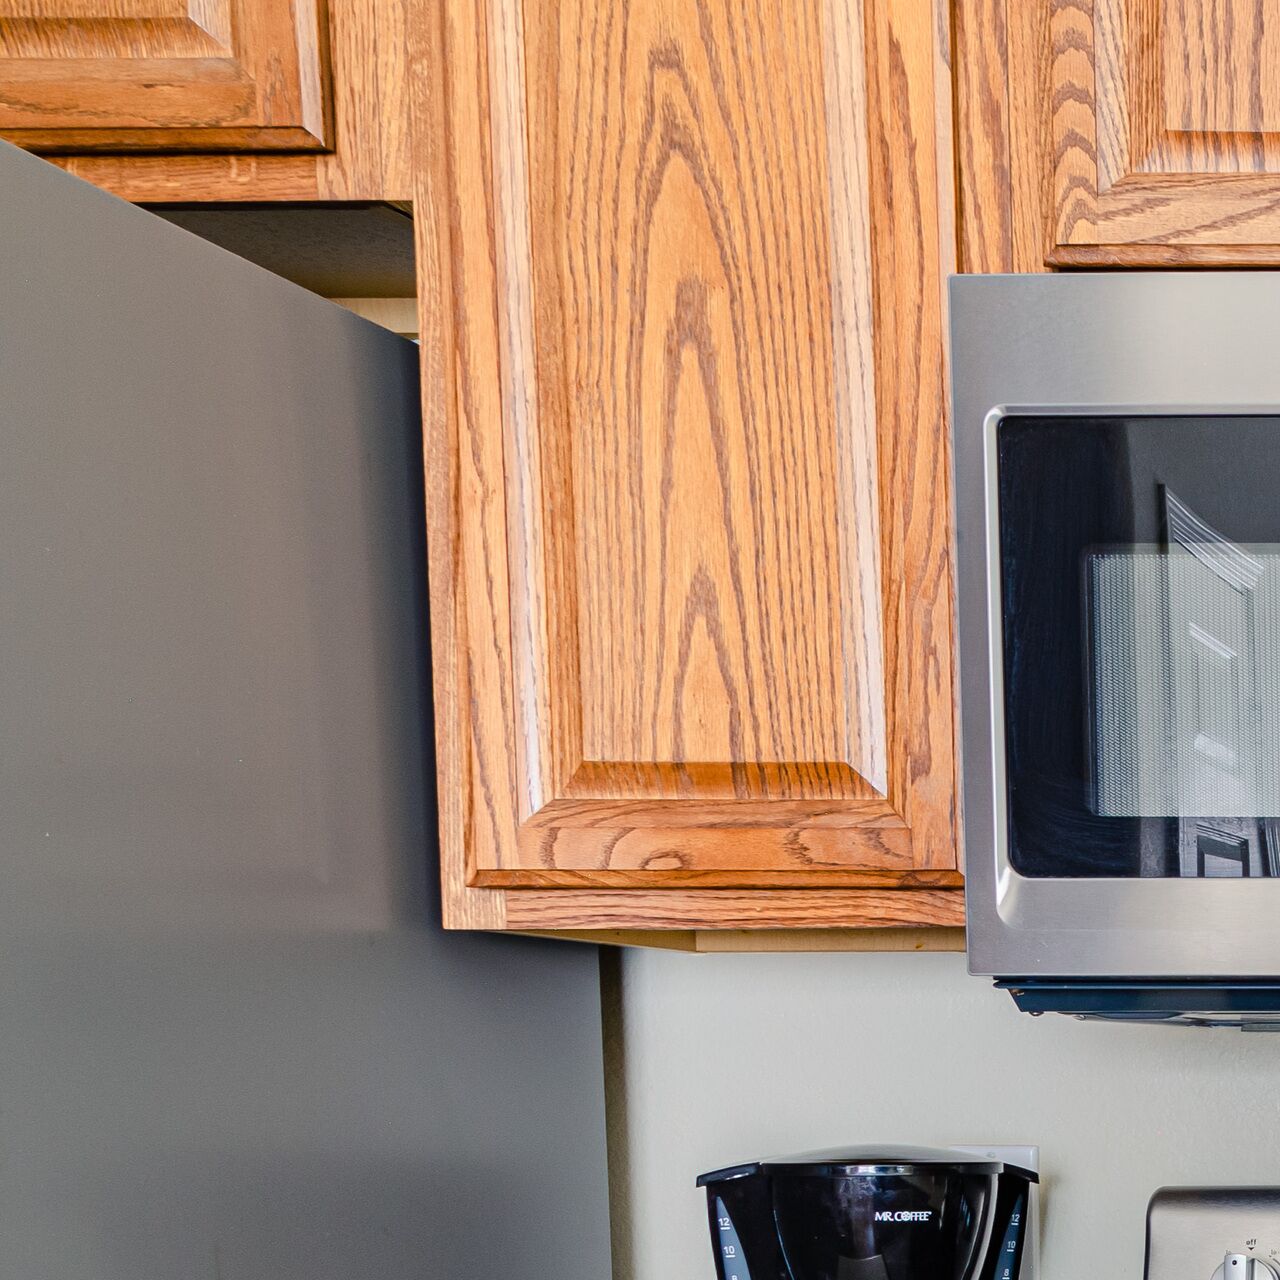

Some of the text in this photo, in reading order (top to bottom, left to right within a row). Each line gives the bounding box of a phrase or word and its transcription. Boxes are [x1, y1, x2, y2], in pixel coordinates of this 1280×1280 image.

[894, 1211, 929, 1221] COFFEE
[1011, 1214, 1020, 1222] 12
[718, 1217, 730, 1226] 12
[1007, 1241, 1016, 1249] 10
[724, 1246, 735, 1254] 10
